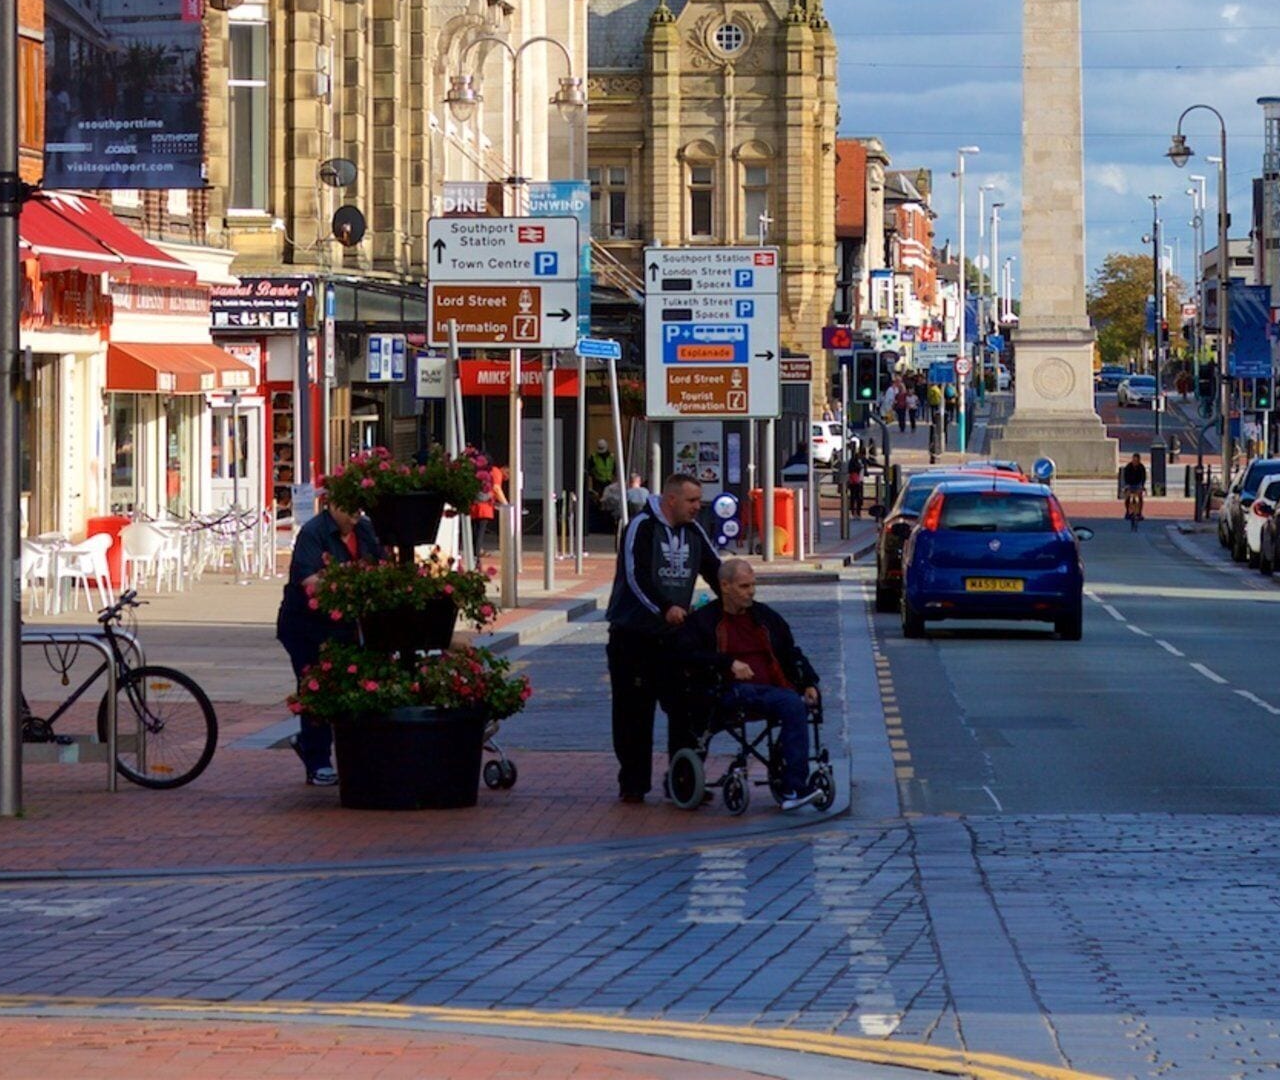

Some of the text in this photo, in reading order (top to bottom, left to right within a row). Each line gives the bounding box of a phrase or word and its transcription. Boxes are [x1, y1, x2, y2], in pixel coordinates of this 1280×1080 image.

[67, 162, 174, 173] visitsouthport.com
[444, 198, 487, 213] DINE
[529, 200, 585, 212] UNWIND
[450, 223, 514, 235] Southport
[460, 236, 506, 247] Station
[662, 253, 751, 263] Southport Station
[451, 258, 530, 270] Town Centre
[662, 267, 732, 276] London Street
[255, 280, 299, 297] Barber
[696, 280, 732, 290] Spaces
[437, 295, 507, 307] Lord Street
[662, 298, 733, 306] Tulketh Street
[695, 310, 730, 320] Spaces
[437, 322, 508, 333] Inormation
[680, 347, 731, 358] Esplanade
[477, 371, 513, 385] MIKE'
[669, 374, 725, 384] Lord Street
[680, 391, 713, 401] Tourist
